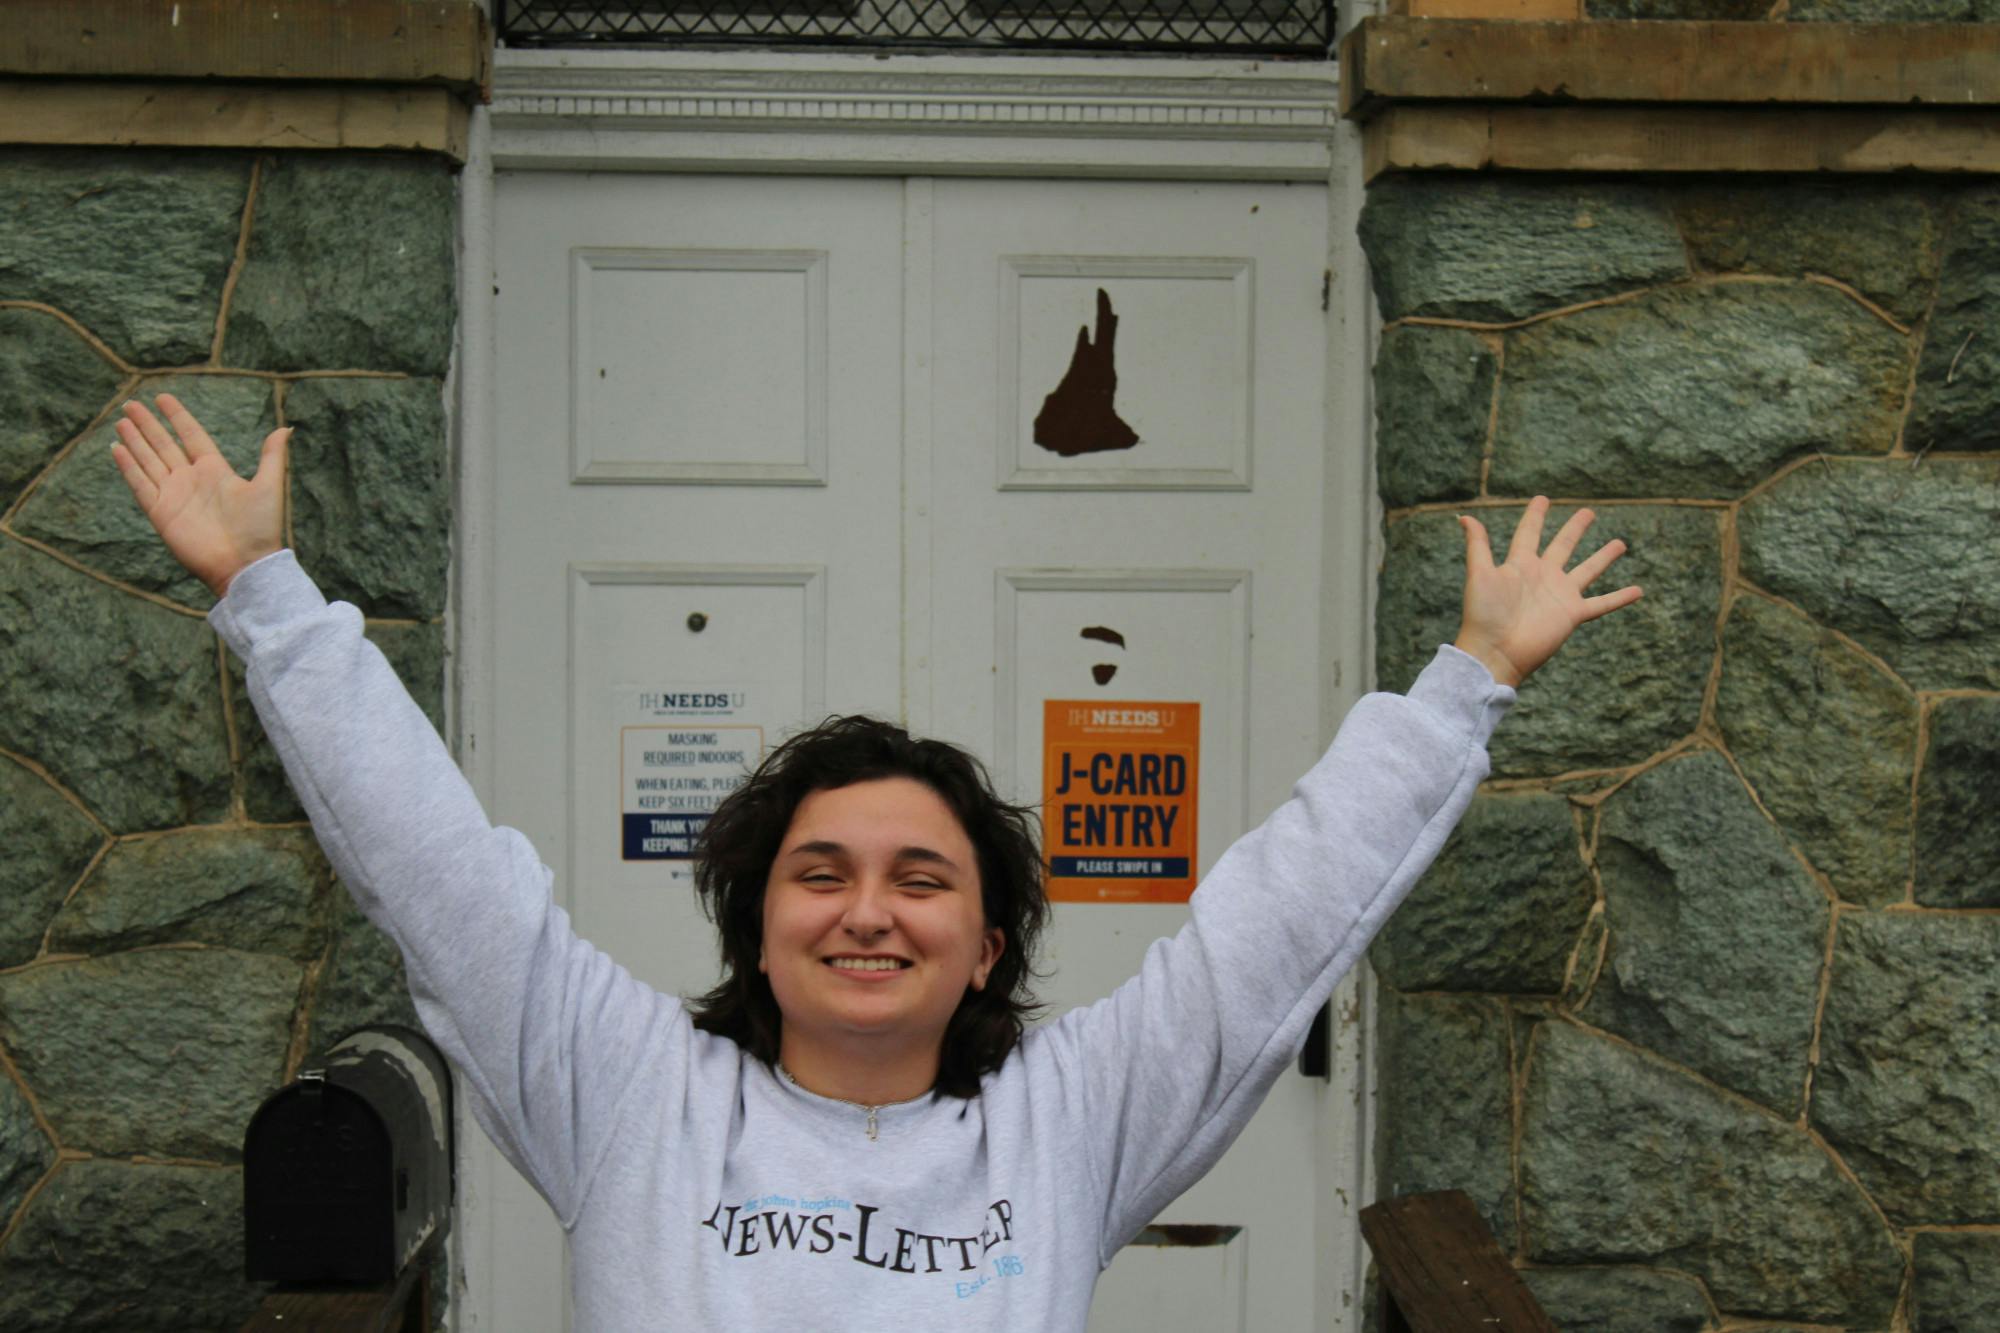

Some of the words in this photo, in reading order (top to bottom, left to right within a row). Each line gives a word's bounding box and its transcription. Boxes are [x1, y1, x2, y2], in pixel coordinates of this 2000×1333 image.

[663, 693, 729, 708] NEEDS
[1091, 709, 1160, 727] NEEDS
[668, 733, 717, 746] MASKING
[644, 751, 696, 766] REQUIRED
[698, 751, 745, 764] INDOORS
[1056, 752, 1186, 796] J-CARD
[636, 778, 668, 791] WHEN
[638, 796, 665, 809] KEEP
[668, 796, 686, 810] SIX
[688, 796, 712, 810] FEET
[650, 819, 687, 834] THANK
[1063, 804, 1179, 847] ENTRY
[642, 838, 689, 853] KEEPING
[1076, 861, 1114, 873] PLEASE
[1116, 861, 1150, 874] SWIPE
[1151, 862, 1163, 874] IN
